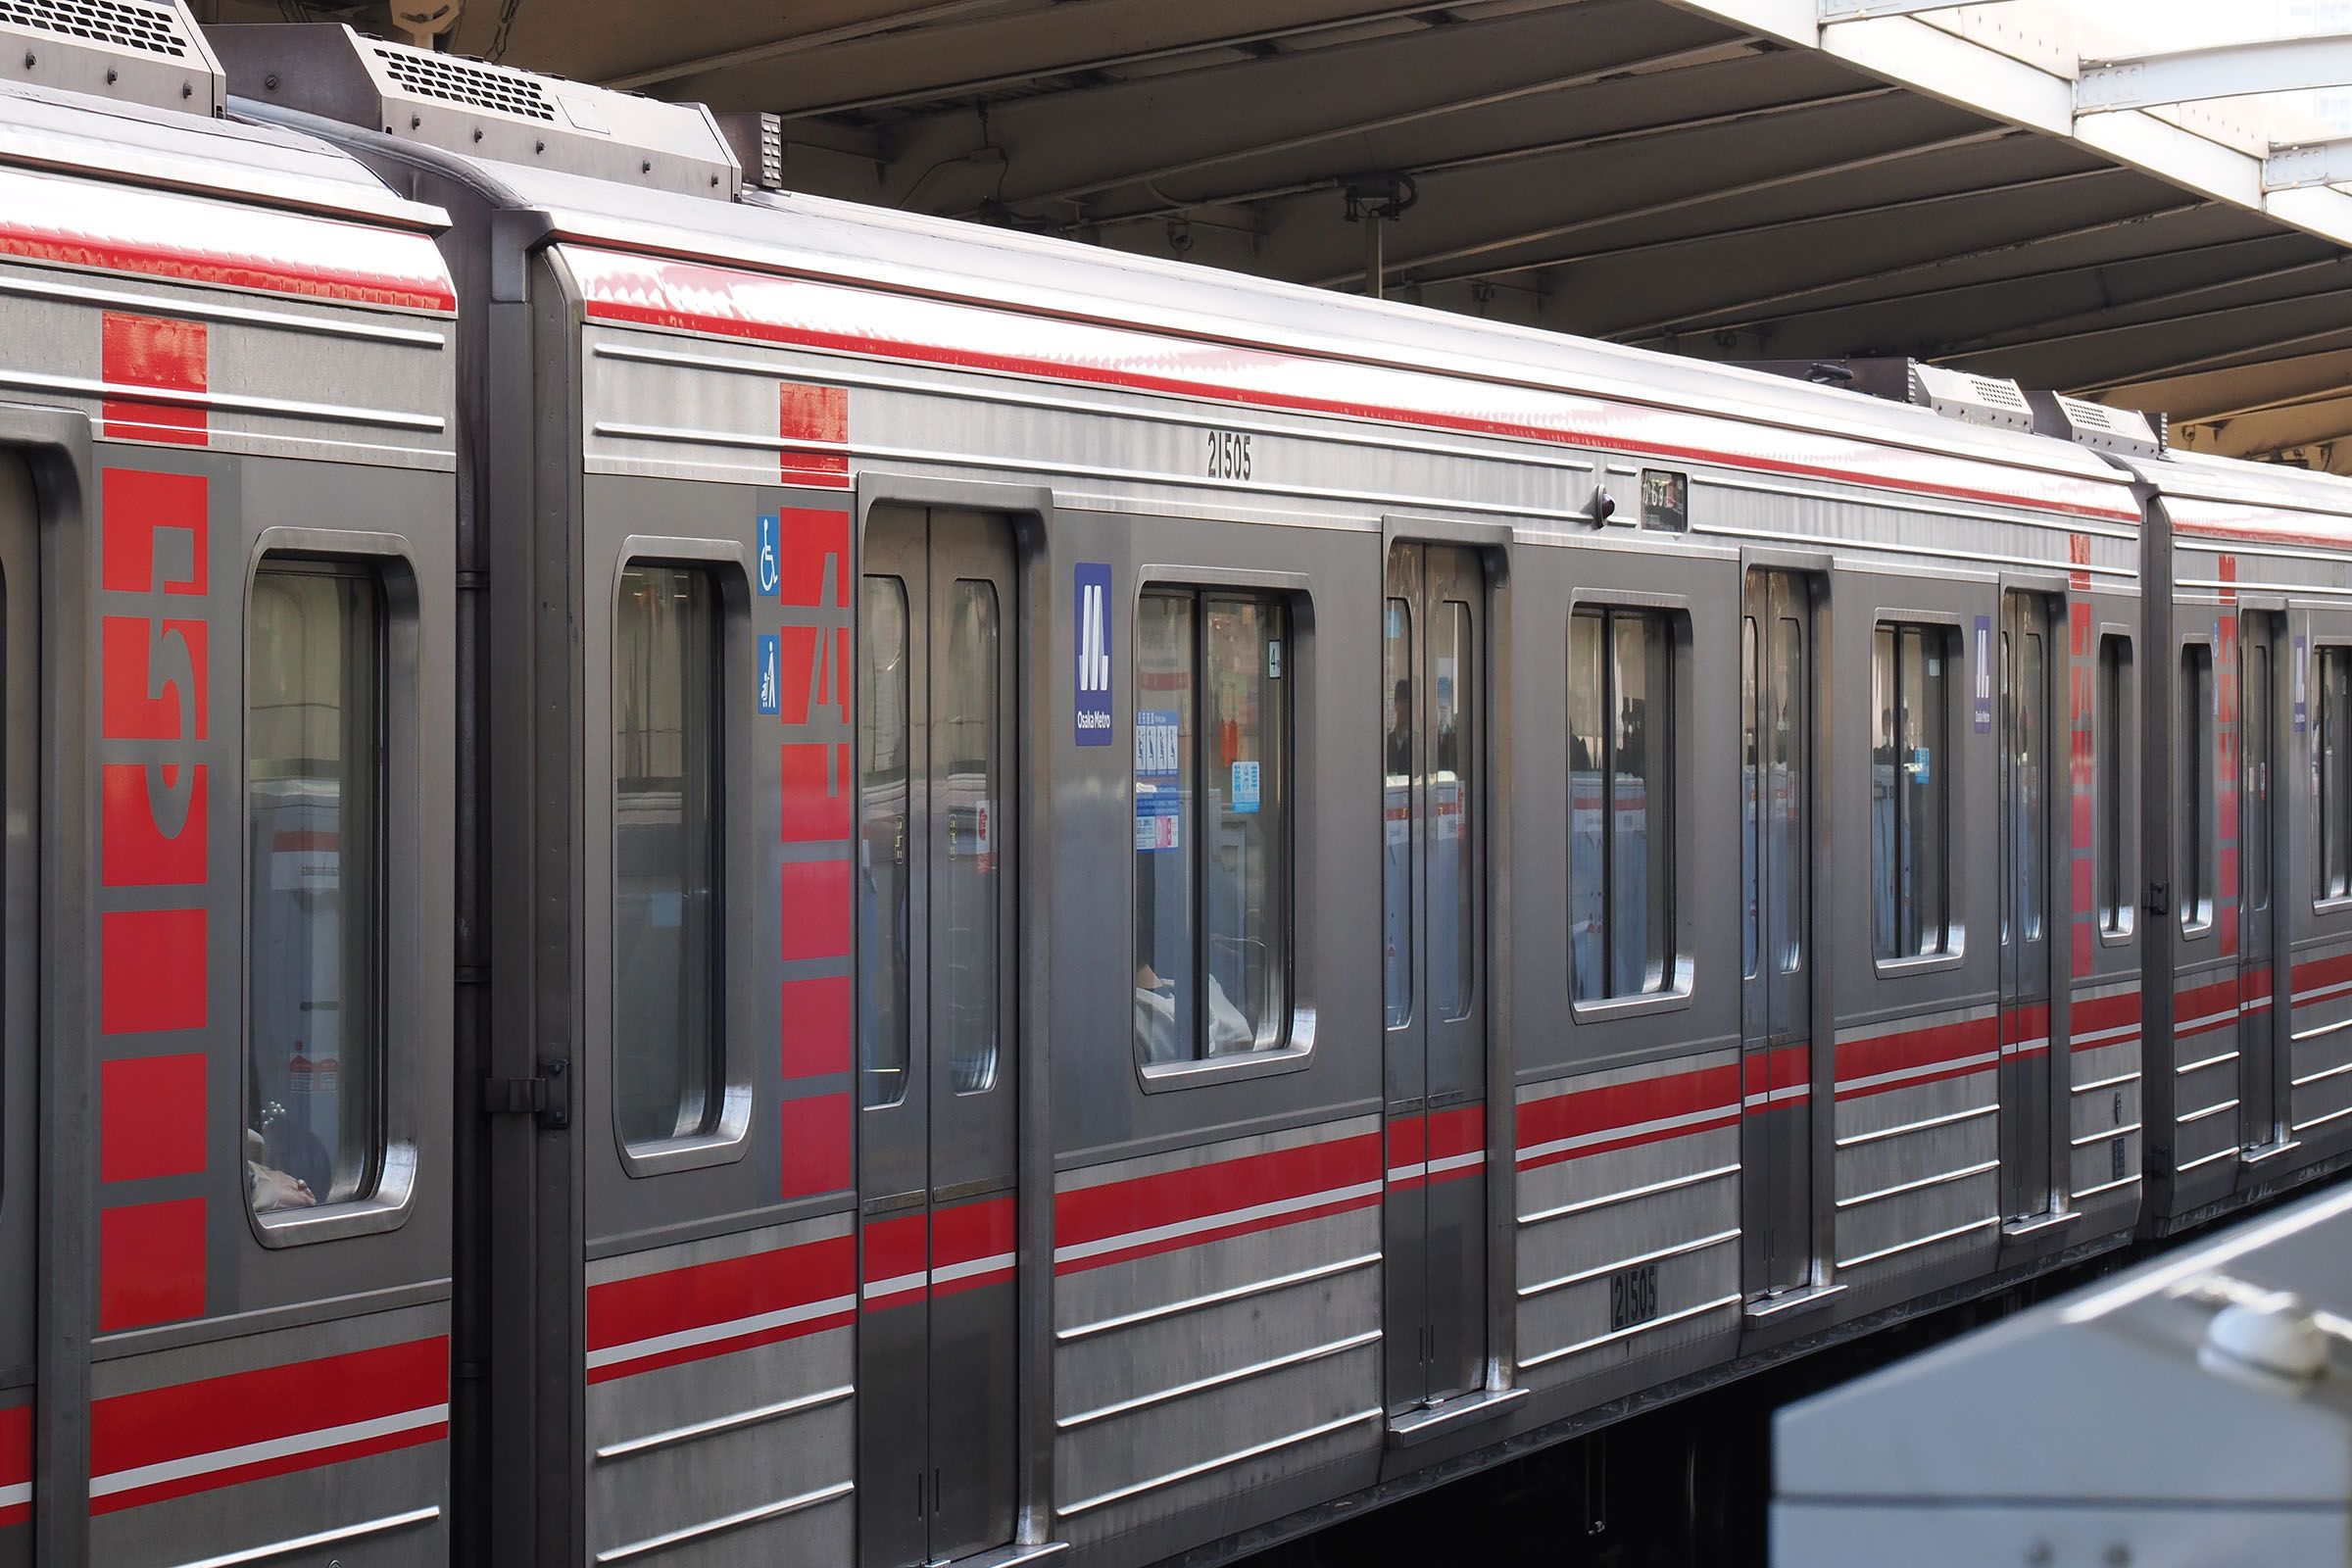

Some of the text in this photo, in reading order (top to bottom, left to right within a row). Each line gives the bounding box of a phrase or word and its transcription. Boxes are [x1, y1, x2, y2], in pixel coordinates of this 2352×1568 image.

[1207, 430, 1251, 481] 21505
[145, 524, 197, 840] 5
[806, 551, 844, 798] 4
[1077, 710, 1111, 729] Osaka Metro
[1614, 1264, 1656, 1327] 21505
